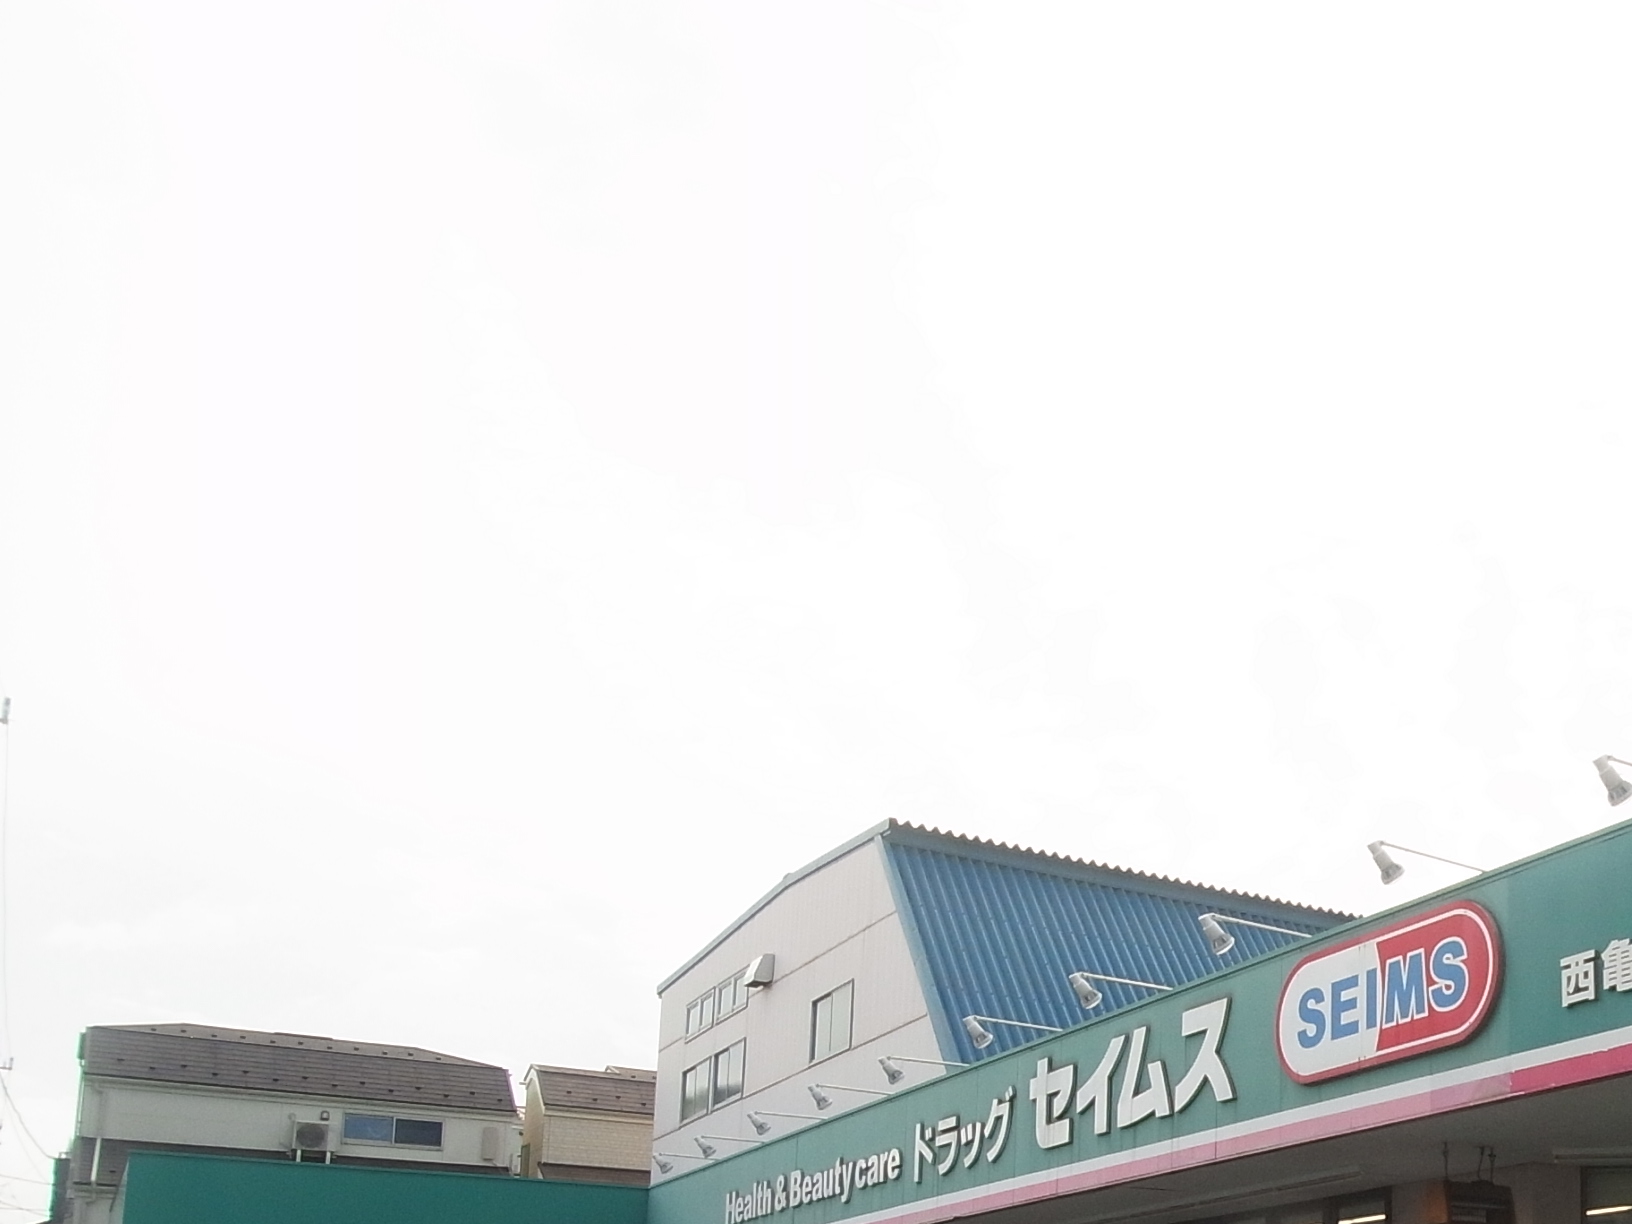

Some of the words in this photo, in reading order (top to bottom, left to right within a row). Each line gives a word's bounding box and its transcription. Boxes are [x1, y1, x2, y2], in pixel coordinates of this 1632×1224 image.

[1296, 938, 1469, 1050] SEIMS
[913, 1086, 1016, 1183] ドラッグ
[1029, 997, 1234, 1149] セイムス
[773, 1175, 787, 1211] &
[789, 1157, 854, 1204] Beauty
[854, 1147, 901, 1190] care
